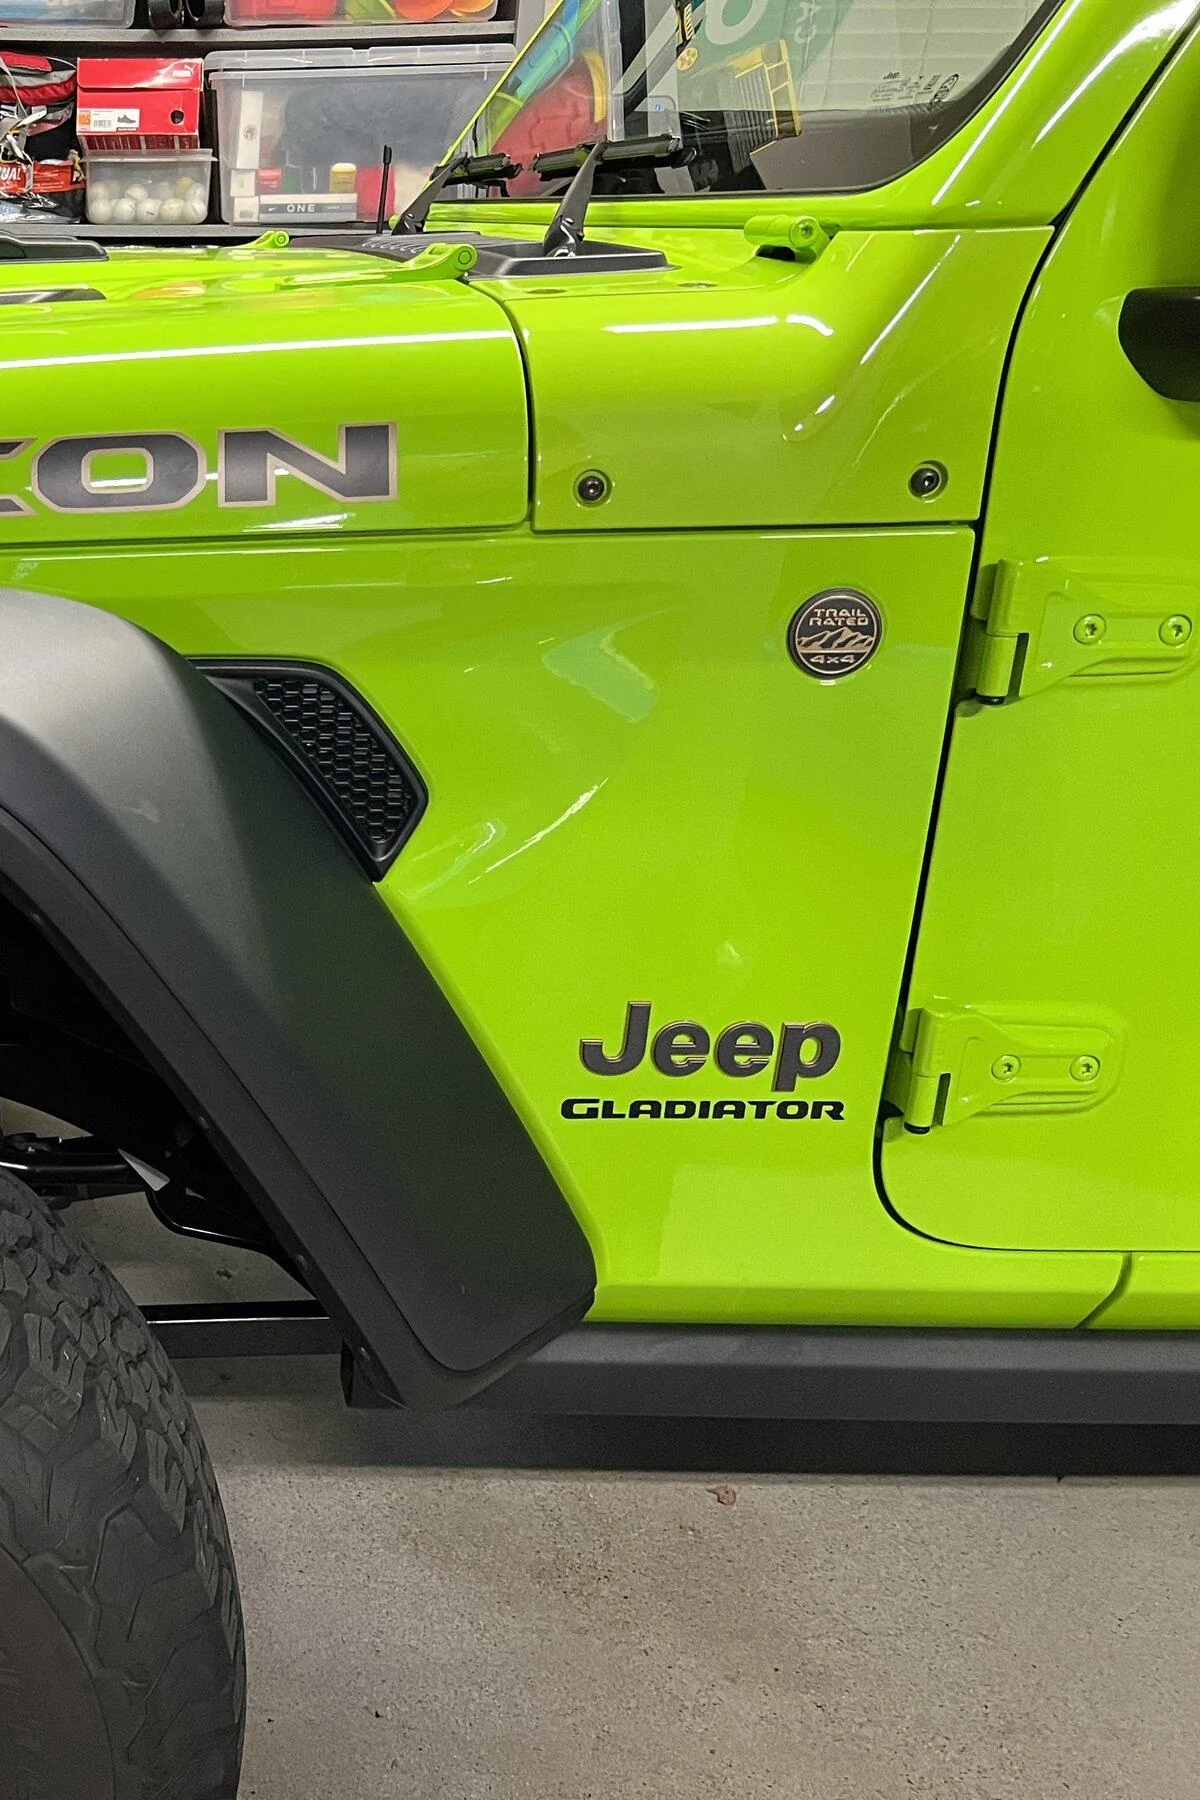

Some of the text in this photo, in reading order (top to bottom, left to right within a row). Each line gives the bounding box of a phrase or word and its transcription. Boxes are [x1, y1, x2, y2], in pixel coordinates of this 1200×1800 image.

[286, 203, 315, 213] ONE
[813, 608, 867, 617] TRAIL
[809, 617, 869, 626] RATED
[579, 1000, 842, 1092] Jeep
[560, 1098, 846, 1120] GLADIATOR
